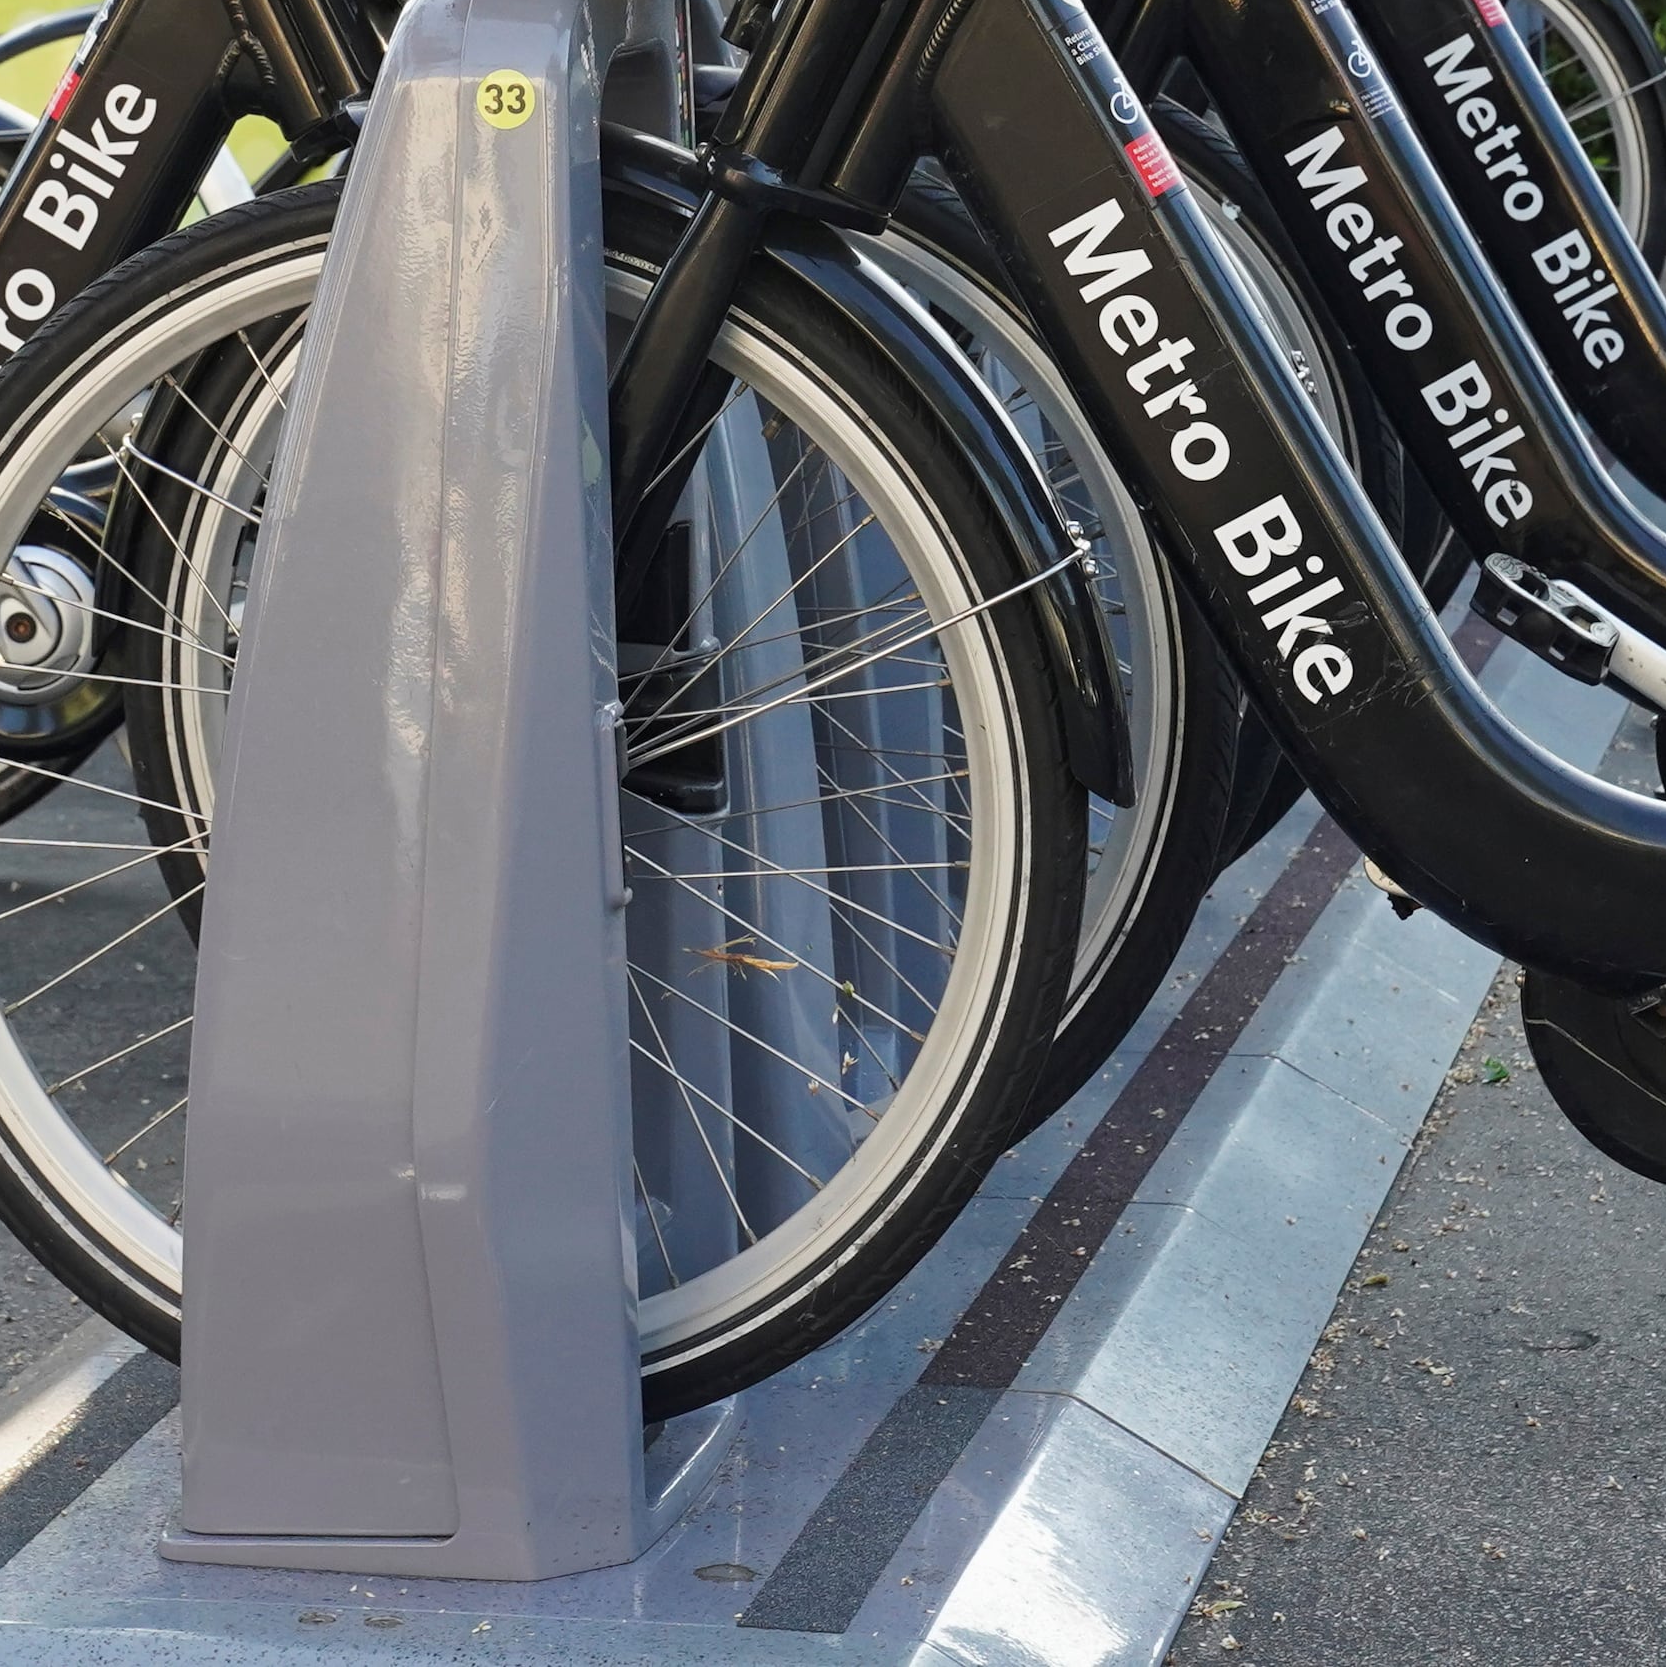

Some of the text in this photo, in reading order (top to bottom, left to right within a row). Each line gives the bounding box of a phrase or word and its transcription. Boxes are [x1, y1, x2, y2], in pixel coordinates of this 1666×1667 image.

[484, 83, 527, 116] 33
[1071, 48, 1078, 57] a
[1076, 50, 1094, 66] Bike
[22, 81, 158, 251] Bike
[1423, 33, 1628, 371] Metro Bike
[1284, 125, 1536, 529] Metro Bike
[1048, 197, 1356, 707] Metro Bike
